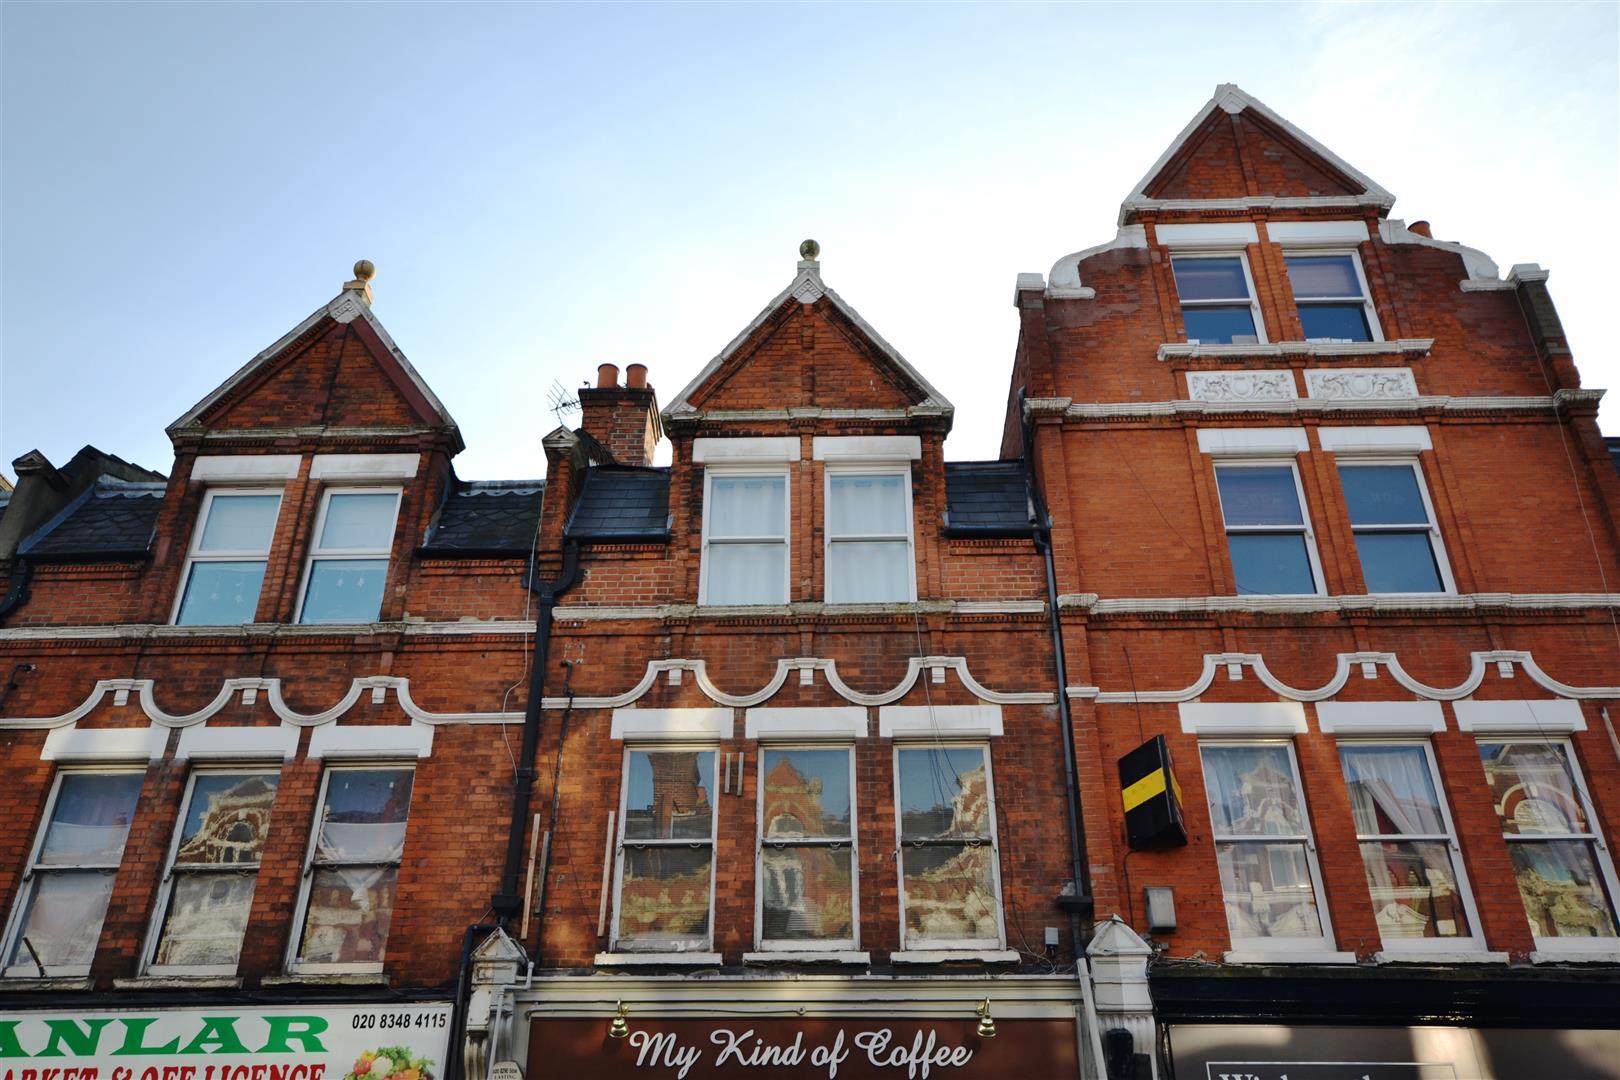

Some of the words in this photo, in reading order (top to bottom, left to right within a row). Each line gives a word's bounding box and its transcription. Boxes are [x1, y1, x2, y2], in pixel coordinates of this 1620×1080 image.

[351, 1014, 376, 1029] 020
[379, 1013, 411, 1029] 8348
[415, 1012, 447, 1028] 4115
[629, 1030, 702, 1080] My
[710, 1029, 807, 1067] Kind
[811, 1028, 849, 1080] of
[854, 1028, 973, 1080] Coffee
